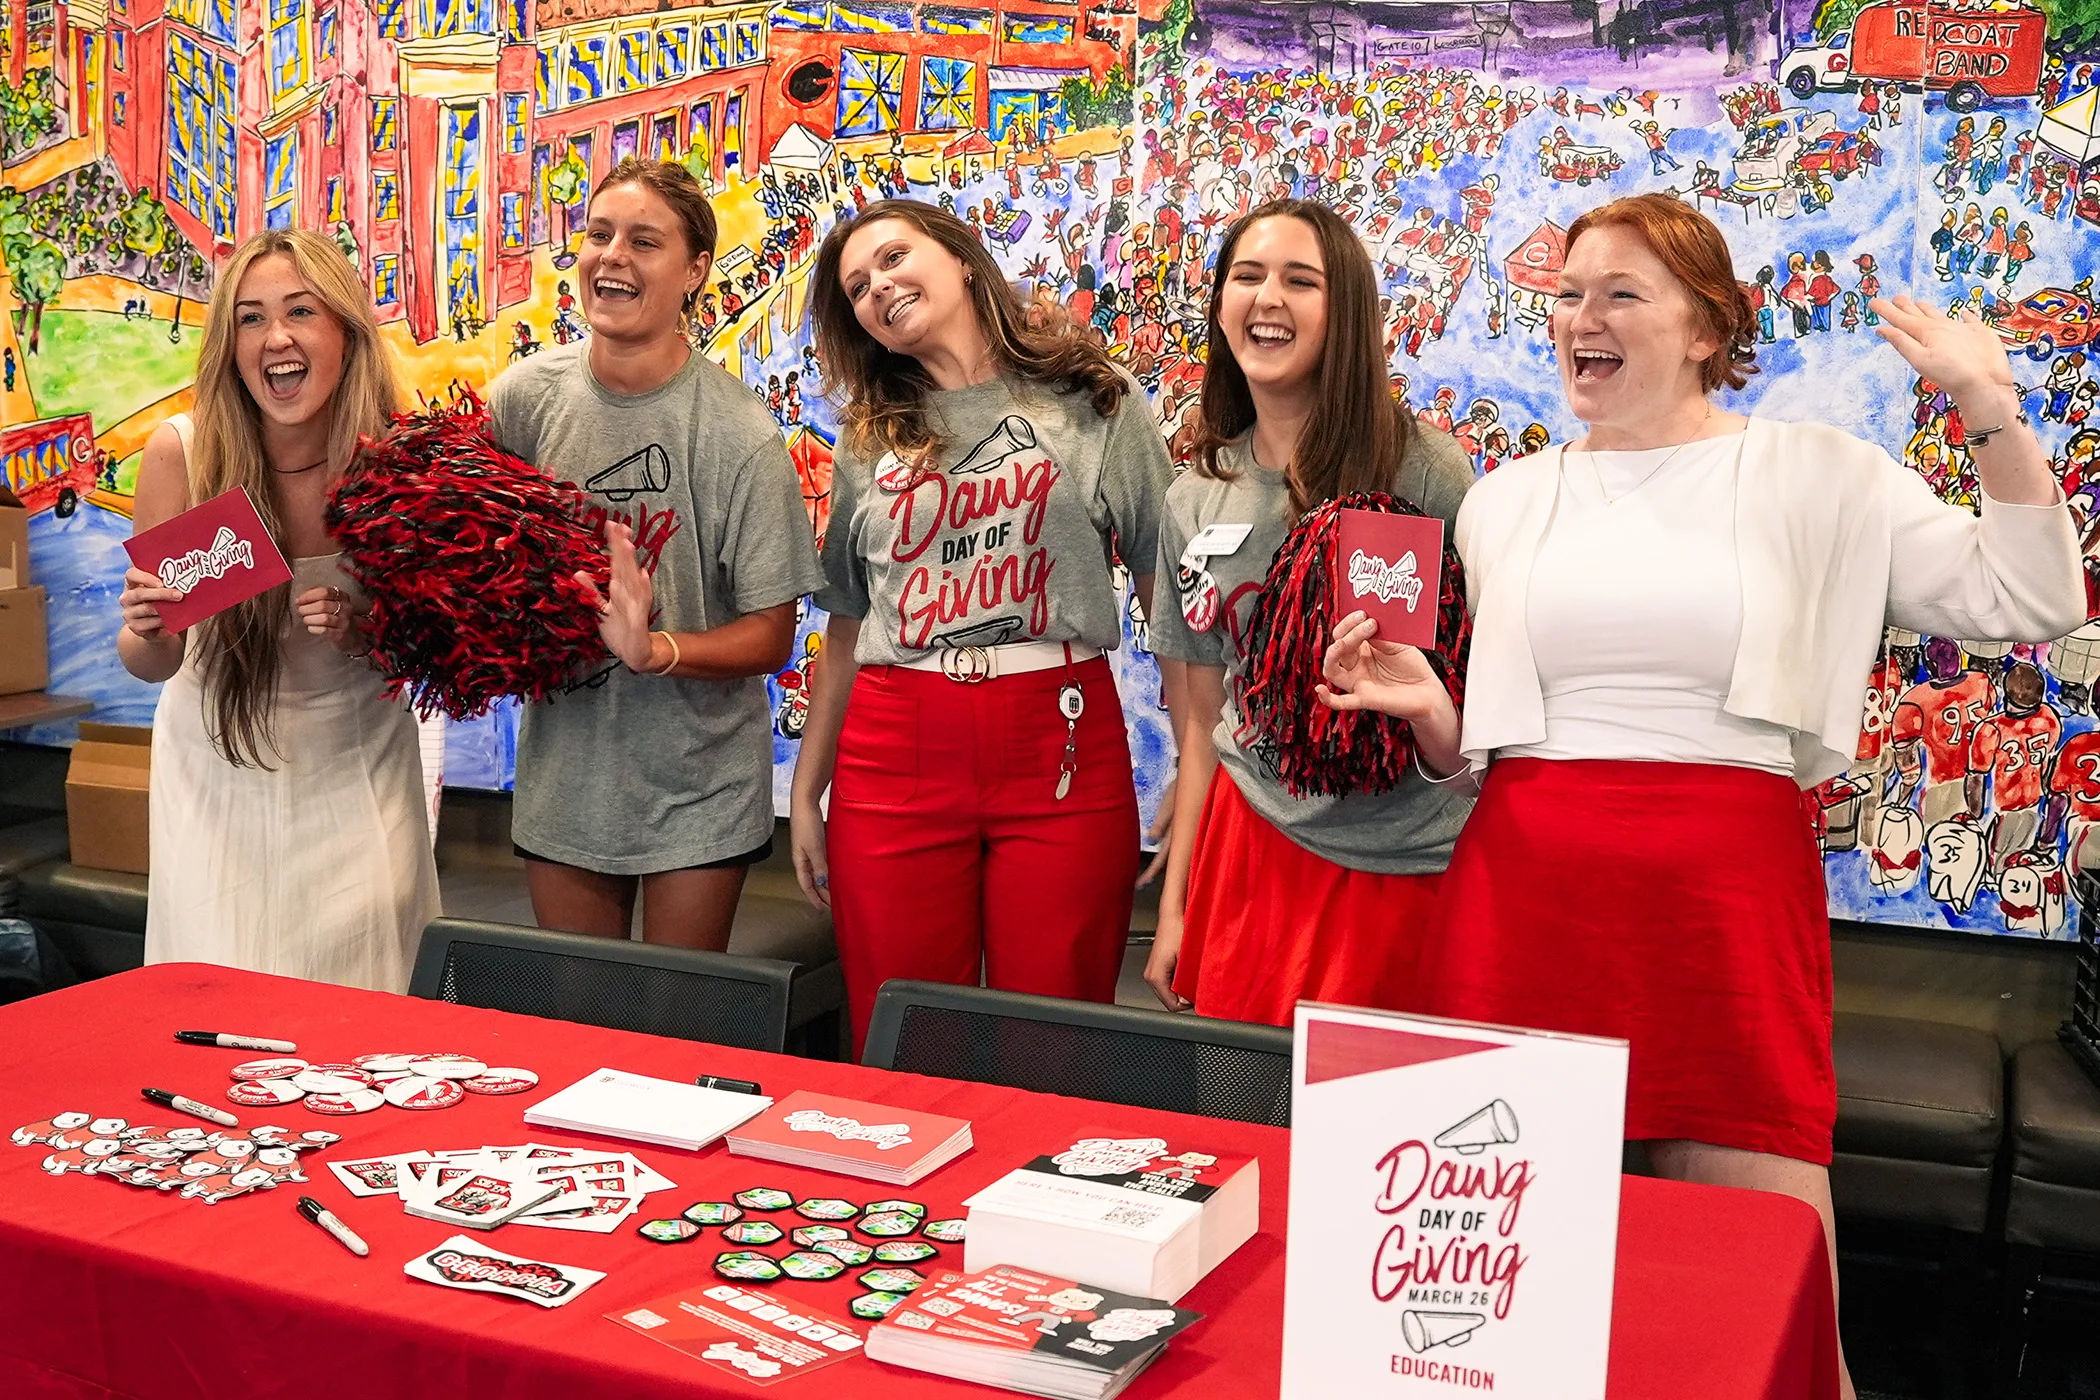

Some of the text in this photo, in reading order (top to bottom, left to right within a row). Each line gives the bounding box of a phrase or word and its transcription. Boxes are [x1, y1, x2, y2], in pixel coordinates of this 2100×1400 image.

[1896, 10, 2020, 45] REDCOAT
[1377, 41, 1421, 52] GATE 10
[1827, 53, 1849, 72] G
[1936, 51, 2009, 77] BAND
[1524, 241, 1550, 267] G
[72, 436, 92, 462] G
[889, 460, 1061, 562] Dawg
[942, 522, 1011, 564] DAY OF
[161, 552, 204, 585] Dawg
[210, 543, 251, 576] Giving
[1351, 553, 1383, 588] Dawg
[1382, 572, 1419, 609] Giving
[898, 547, 1056, 649] Giving
[1942, 699, 1984, 745] 95
[2001, 732, 2050, 772] 35
[1940, 845, 1960, 864] 35
[2009, 879, 2031, 893] 34
[1057, 1151, 1142, 1172] Giving
[1075, 1140, 1159, 1161] Dawg
[1123, 1182, 1181, 1198] THE CALL?
[1138, 1180, 1188, 1193] ANSWER
[1141, 1173, 1195, 1188] WILL YOU
[1375, 1140, 1537, 1236] Dawg
[1056, 1187, 1080, 1196] HOW
[1086, 1193, 1106, 1201] YOU
[1110, 1197, 1132, 1206] CAN
[1419, 1209, 1486, 1232] DAY OF
[434, 1251, 567, 1295] GEORGIA
[1371, 1224, 1529, 1320] Giving
[965, 1280, 1008, 1297] ALL
[1408, 1289, 1488, 1305] MARCH 26
[946, 1288, 1030, 1316] DAWGS!
[1391, 1354, 1495, 1391] EDUCATION
